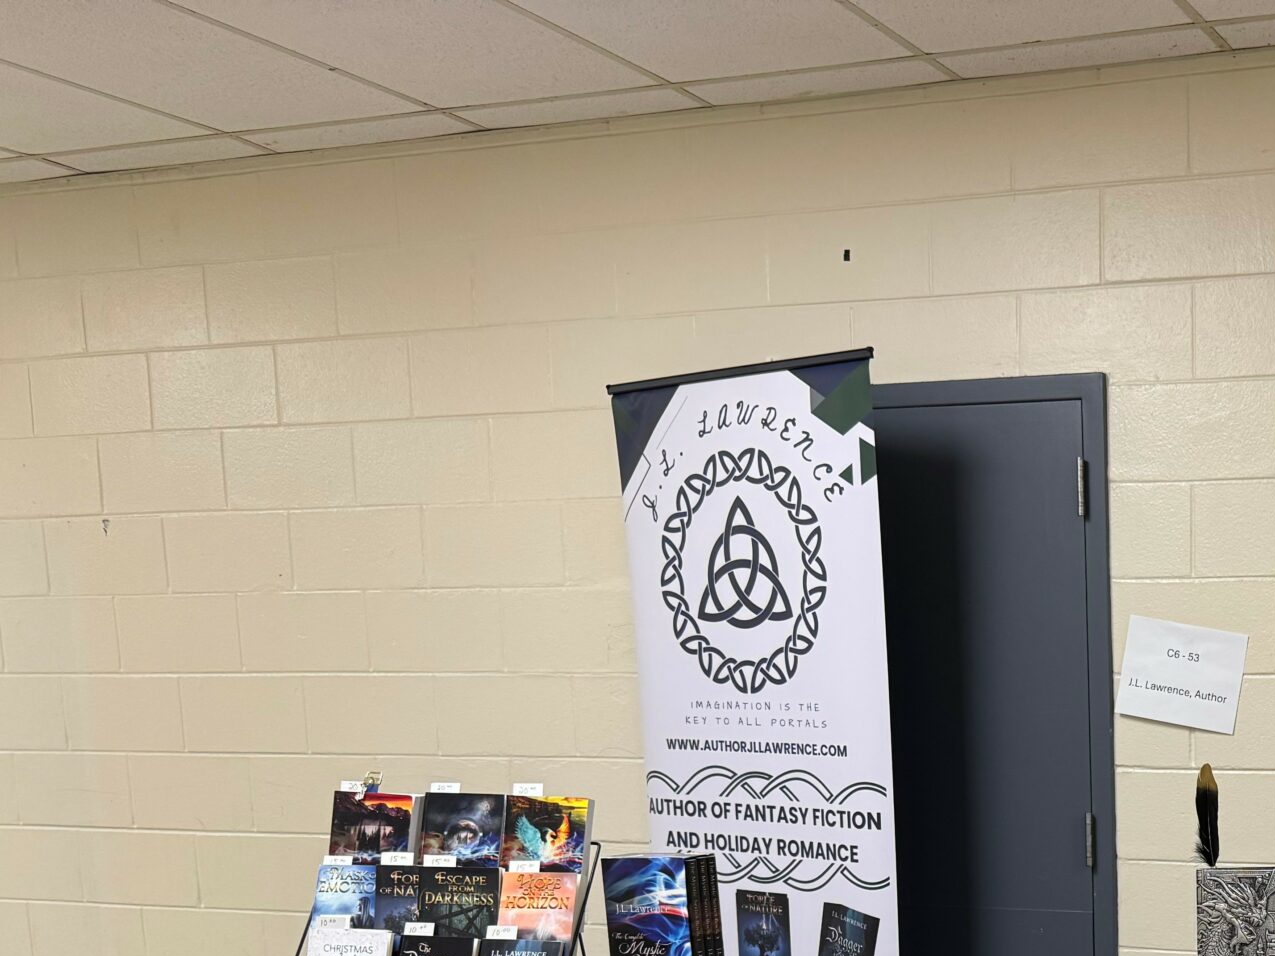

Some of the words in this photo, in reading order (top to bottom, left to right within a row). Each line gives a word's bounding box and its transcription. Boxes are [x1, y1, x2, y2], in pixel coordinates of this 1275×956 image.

[697, 400, 845, 503] LAWRENCE
[1167, 648, 1180, 658] C6
[1187, 652, 1200, 662] 53
[1128, 677, 1143, 688] J.L.
[1145, 680, 1192, 698] Lawrence,
[1194, 689, 1228, 704] Author
[690, 700, 771, 711] IMAGINATION
[779, 702, 791, 712] IS
[799, 702, 821, 712] THE
[685, 715, 707, 725] KEY
[716, 716, 730, 726] TO
[738, 716, 762, 727] ALL
[770, 718, 828, 729] PORTALS
[666, 738, 848, 758] WWW.AUTHORJLLAWRENCE.COM
[648, 797, 708, 819] AUTHOR
[711, 801, 731, 819] OF
[735, 802, 809, 827] FANTASY
[812, 808, 882, 831] FICTION
[666, 830, 700, 848] AND
[704, 832, 774, 857] HOLIDAY
[777, 838, 859, 863] ROMANCE
[435, 871, 487, 886] ESCAPE
[517, 873, 562, 890] HOPE
[425, 892, 494, 906] DARKNESS
[505, 896, 570, 910] HORIZON
[825, 926, 863, 953] Dagger
[323, 944, 374, 955] CHRISTMAS
[418, 942, 431, 953] The
